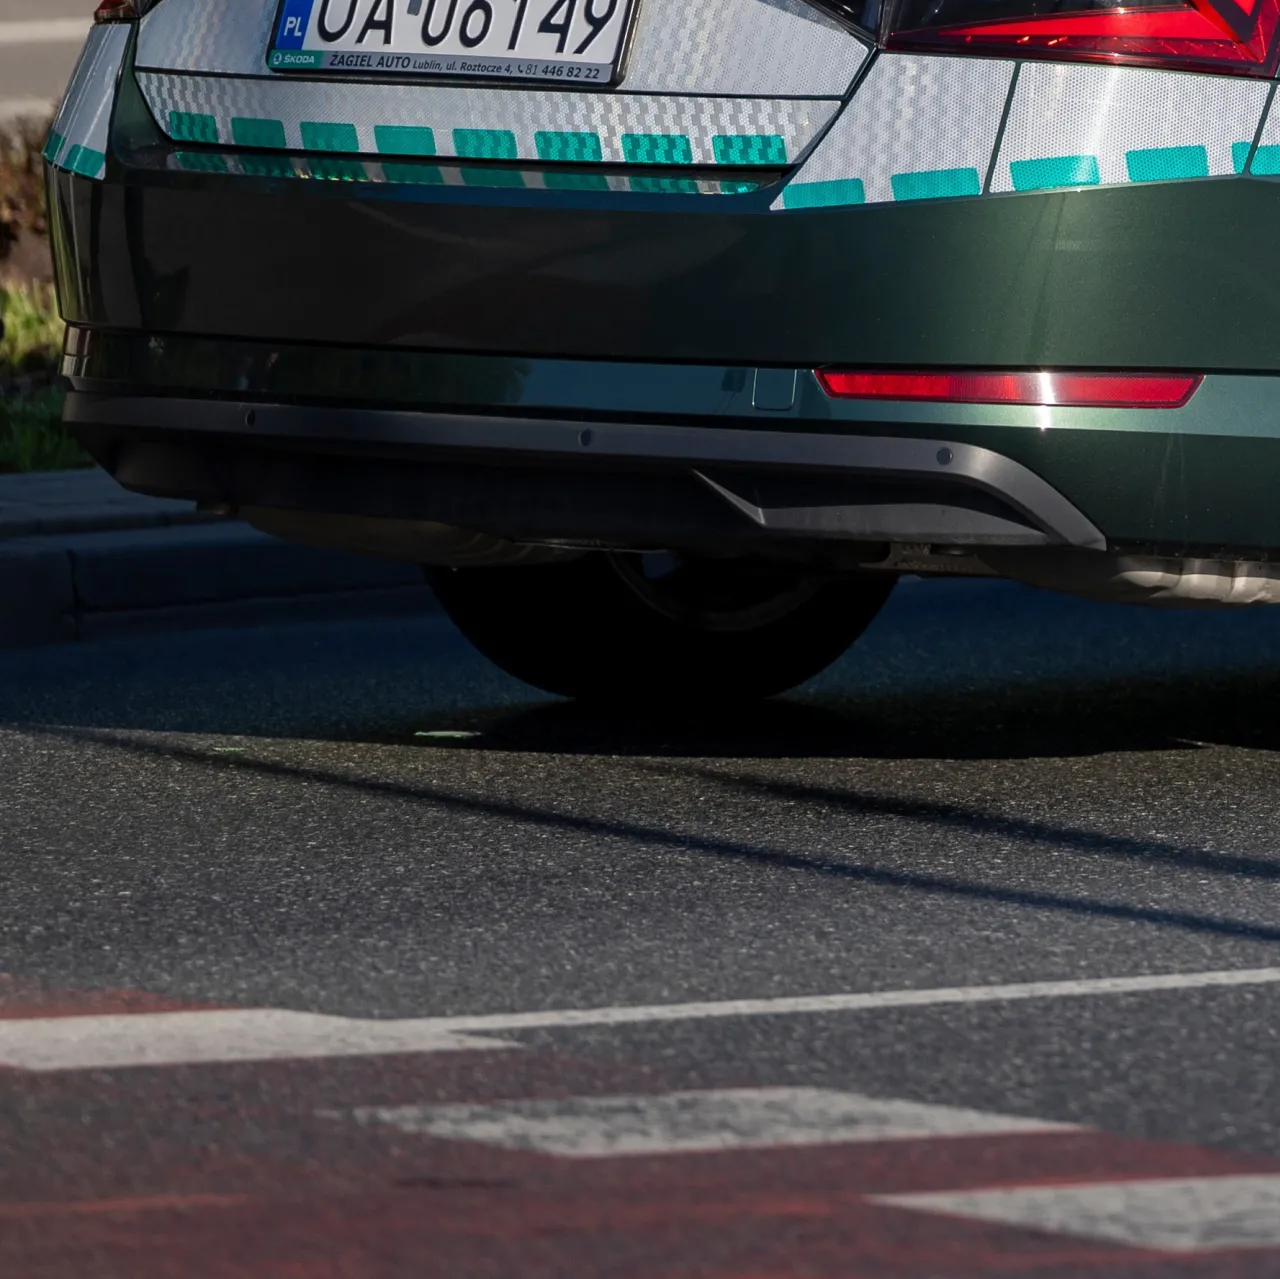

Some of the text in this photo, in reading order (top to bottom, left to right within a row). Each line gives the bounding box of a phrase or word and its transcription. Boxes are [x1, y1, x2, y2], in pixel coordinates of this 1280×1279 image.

[283, 16, 302, 37] PL
[283, 53, 315, 64] ŠKODA
[329, 51, 600, 80] ŻAGIEL AUTO Lublin, ul. Roztocze 4, 81 446 82 22
